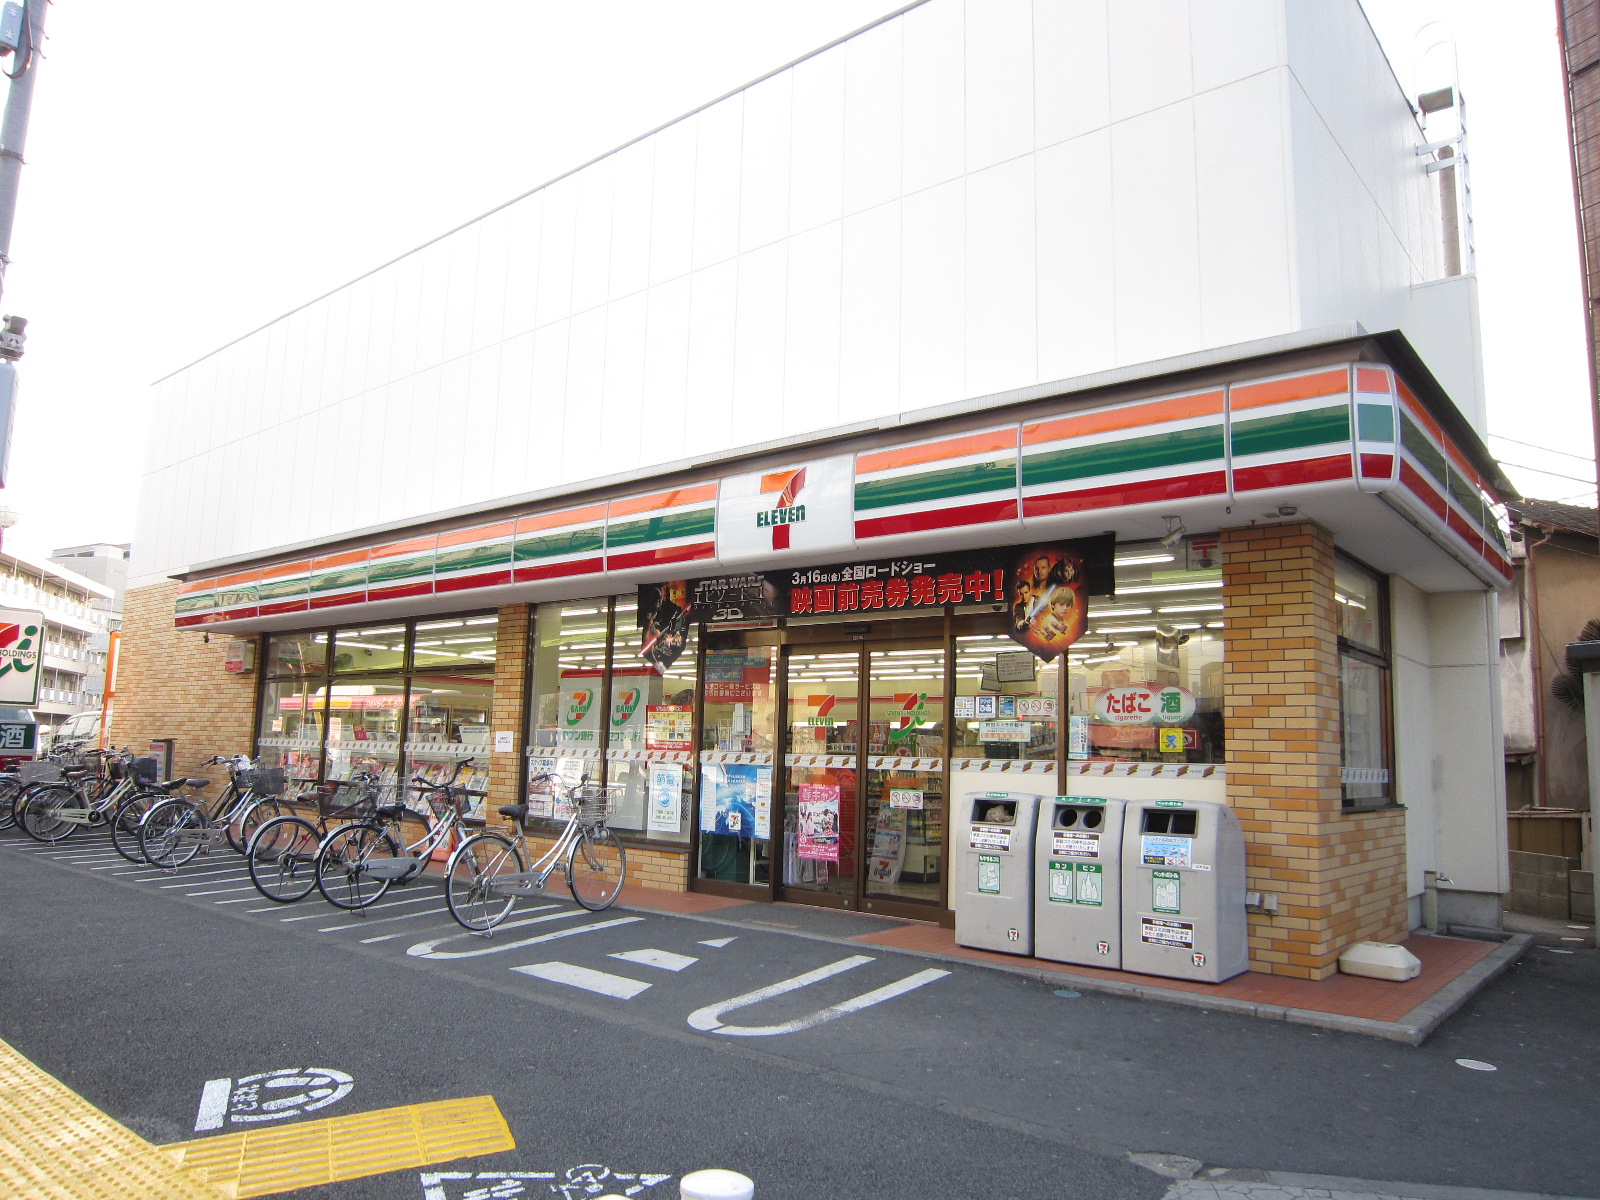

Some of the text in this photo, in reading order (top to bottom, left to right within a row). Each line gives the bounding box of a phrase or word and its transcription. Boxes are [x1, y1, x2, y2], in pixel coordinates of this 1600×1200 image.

[757, 505, 806, 527] ELEVEN
[695, 575, 765, 592] STAR WARS
[712, 608, 744, 620] 3D
[571, 705, 588, 713] BANK
[616, 705, 634, 713] BANK
[1106, 691, 1181, 714] たばこ 酒
[808, 717, 834, 726] ELEVEN
[0, 725, 26, 748] 酒
